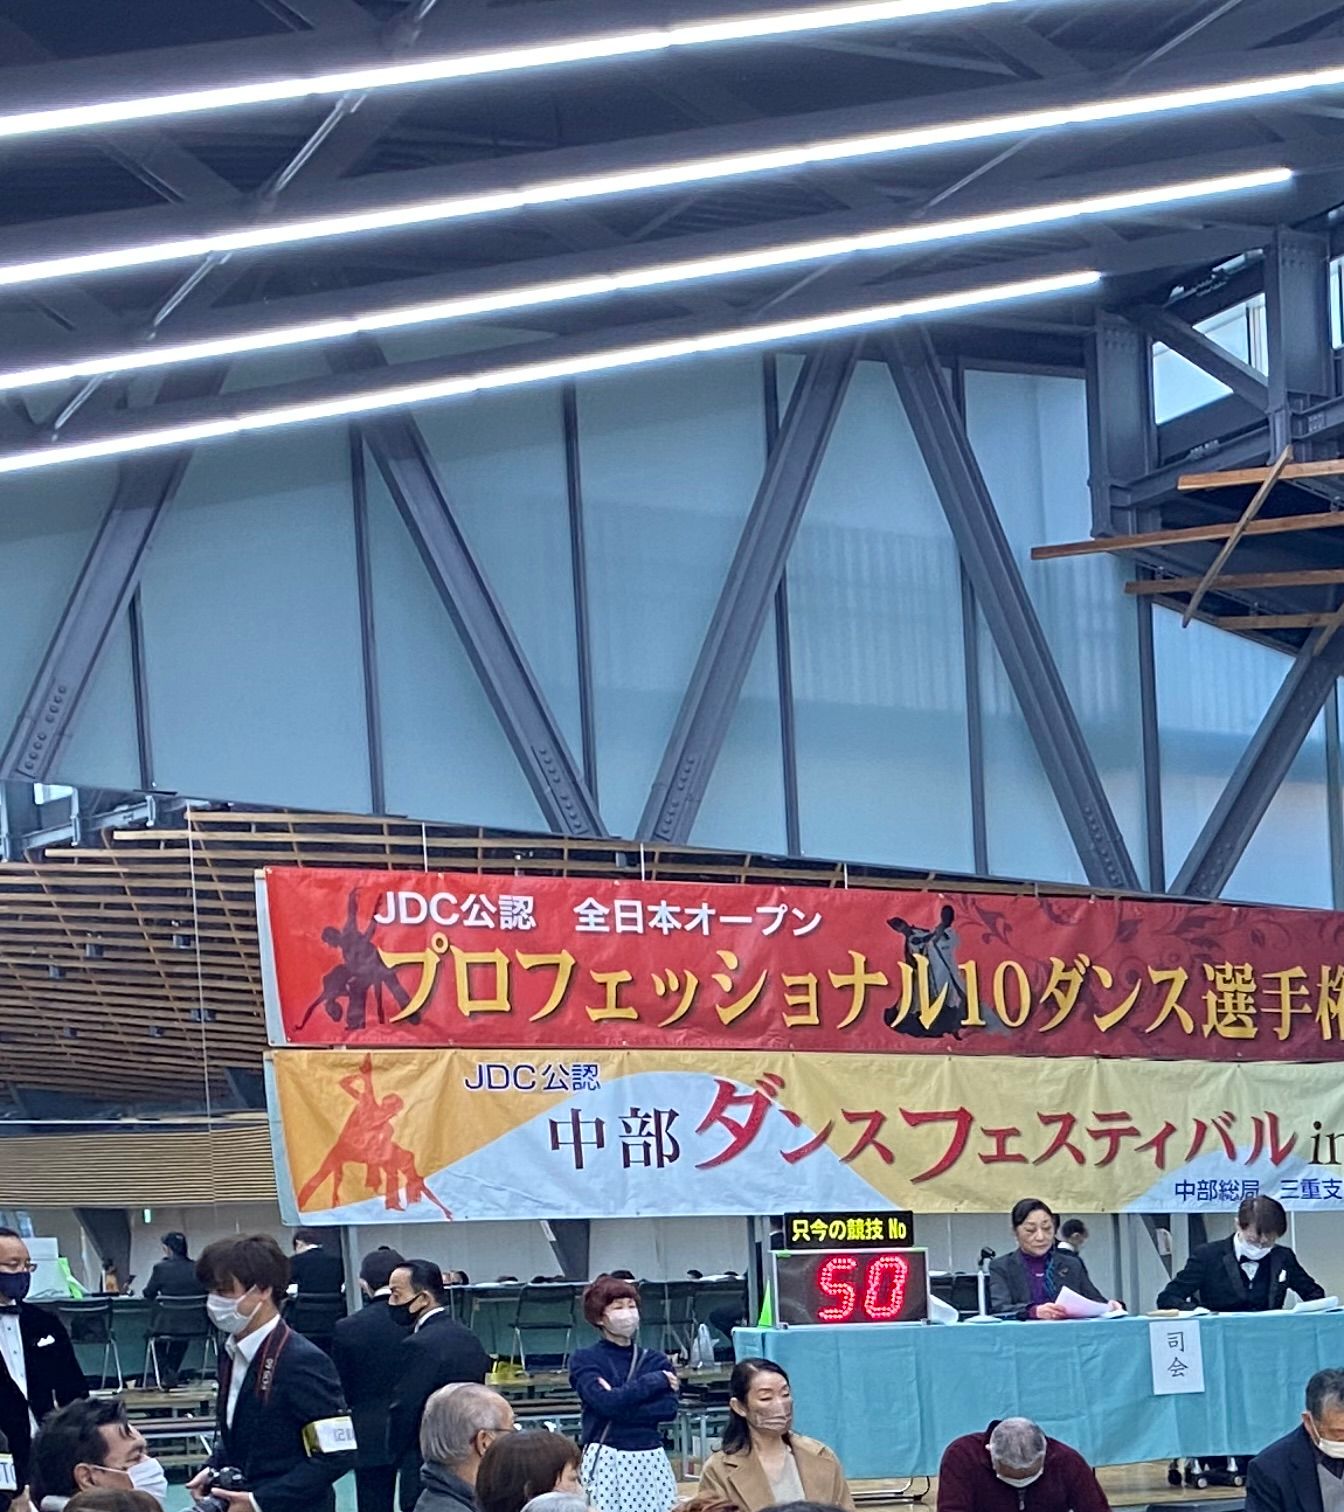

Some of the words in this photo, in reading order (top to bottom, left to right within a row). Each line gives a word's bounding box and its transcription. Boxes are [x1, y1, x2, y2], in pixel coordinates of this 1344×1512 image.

[374, 891, 537, 933] JDC公認
[573, 897, 823, 938] 全日本オープン
[791, 1217, 884, 1241] 只今の競技
[818, 1255, 909, 1321] 50
[1166, 1331, 1189, 1377] 司会
